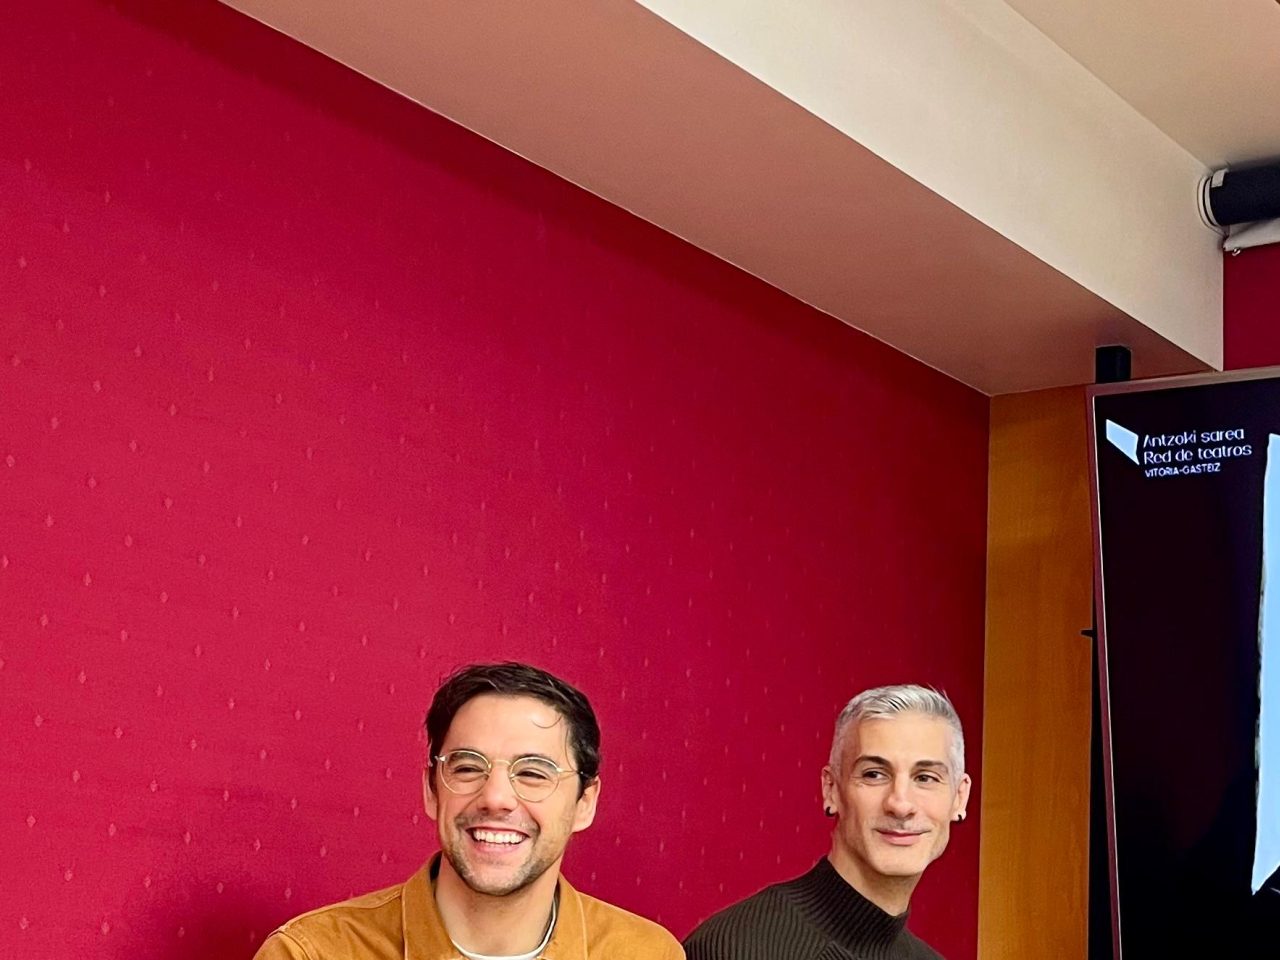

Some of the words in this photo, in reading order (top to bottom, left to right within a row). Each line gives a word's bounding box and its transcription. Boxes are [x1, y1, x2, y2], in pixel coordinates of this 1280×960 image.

[1143, 429, 1197, 449] Antzoki
[1200, 428, 1245, 443] sarea
[1143, 450, 1172, 465] Red
[1175, 448, 1193, 462] de
[1198, 444, 1252, 460] teatros
[1144, 462, 1221, 478] VITORIA-GASTEIZ
